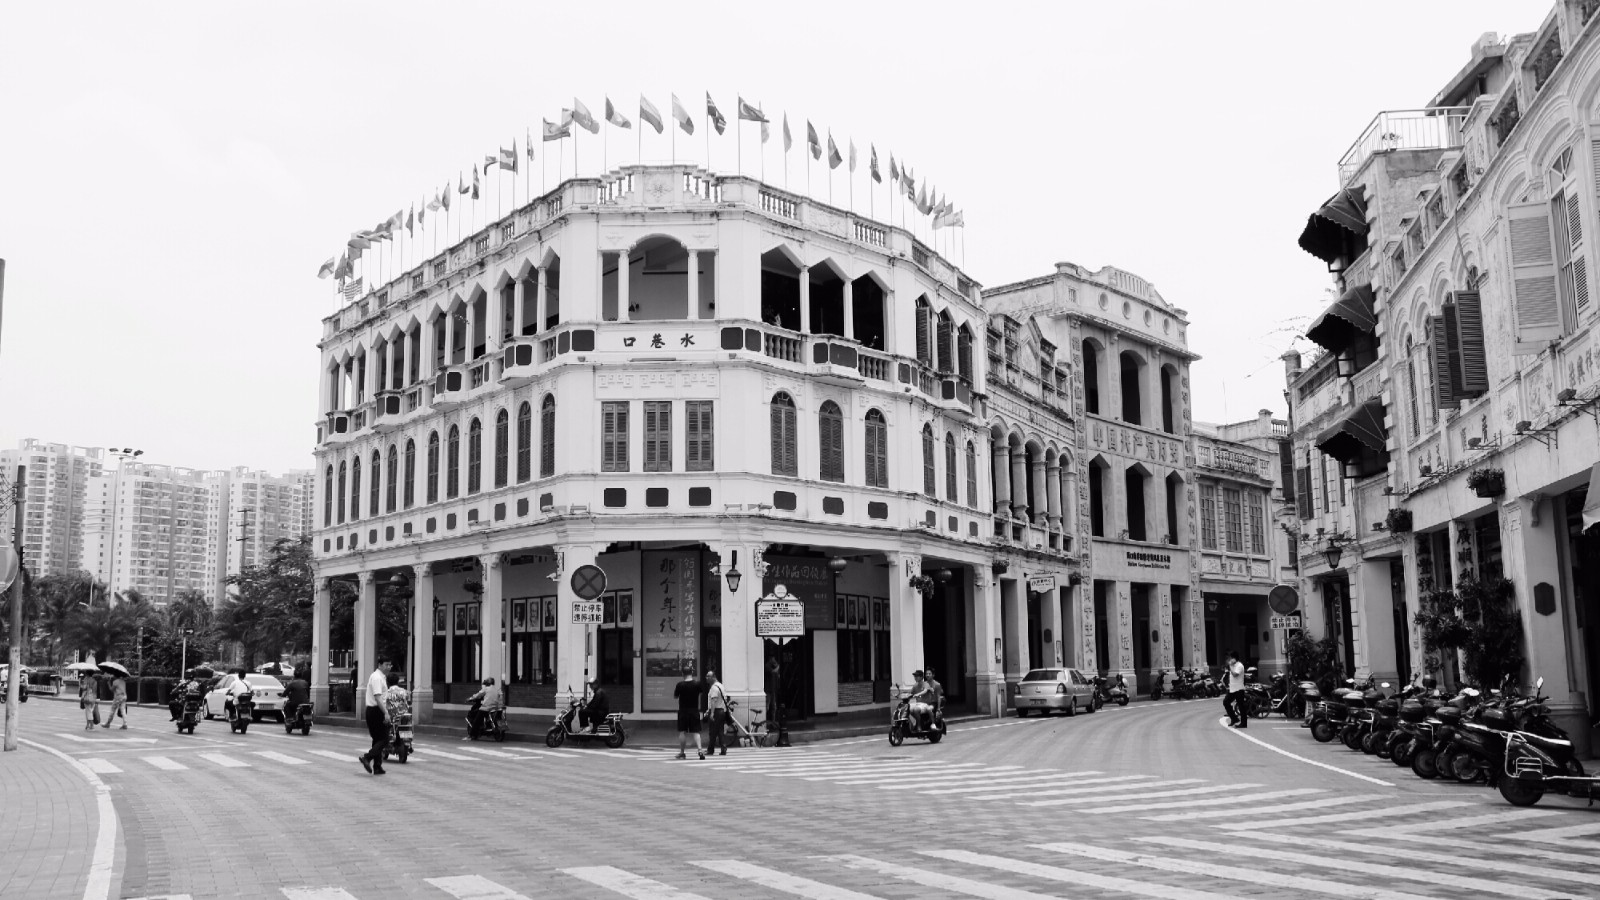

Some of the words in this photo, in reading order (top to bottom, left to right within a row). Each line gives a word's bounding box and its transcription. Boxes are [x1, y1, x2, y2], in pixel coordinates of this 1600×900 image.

[573, 604, 602, 613] 禁止停车
[659, 557, 677, 633] 那个年代
